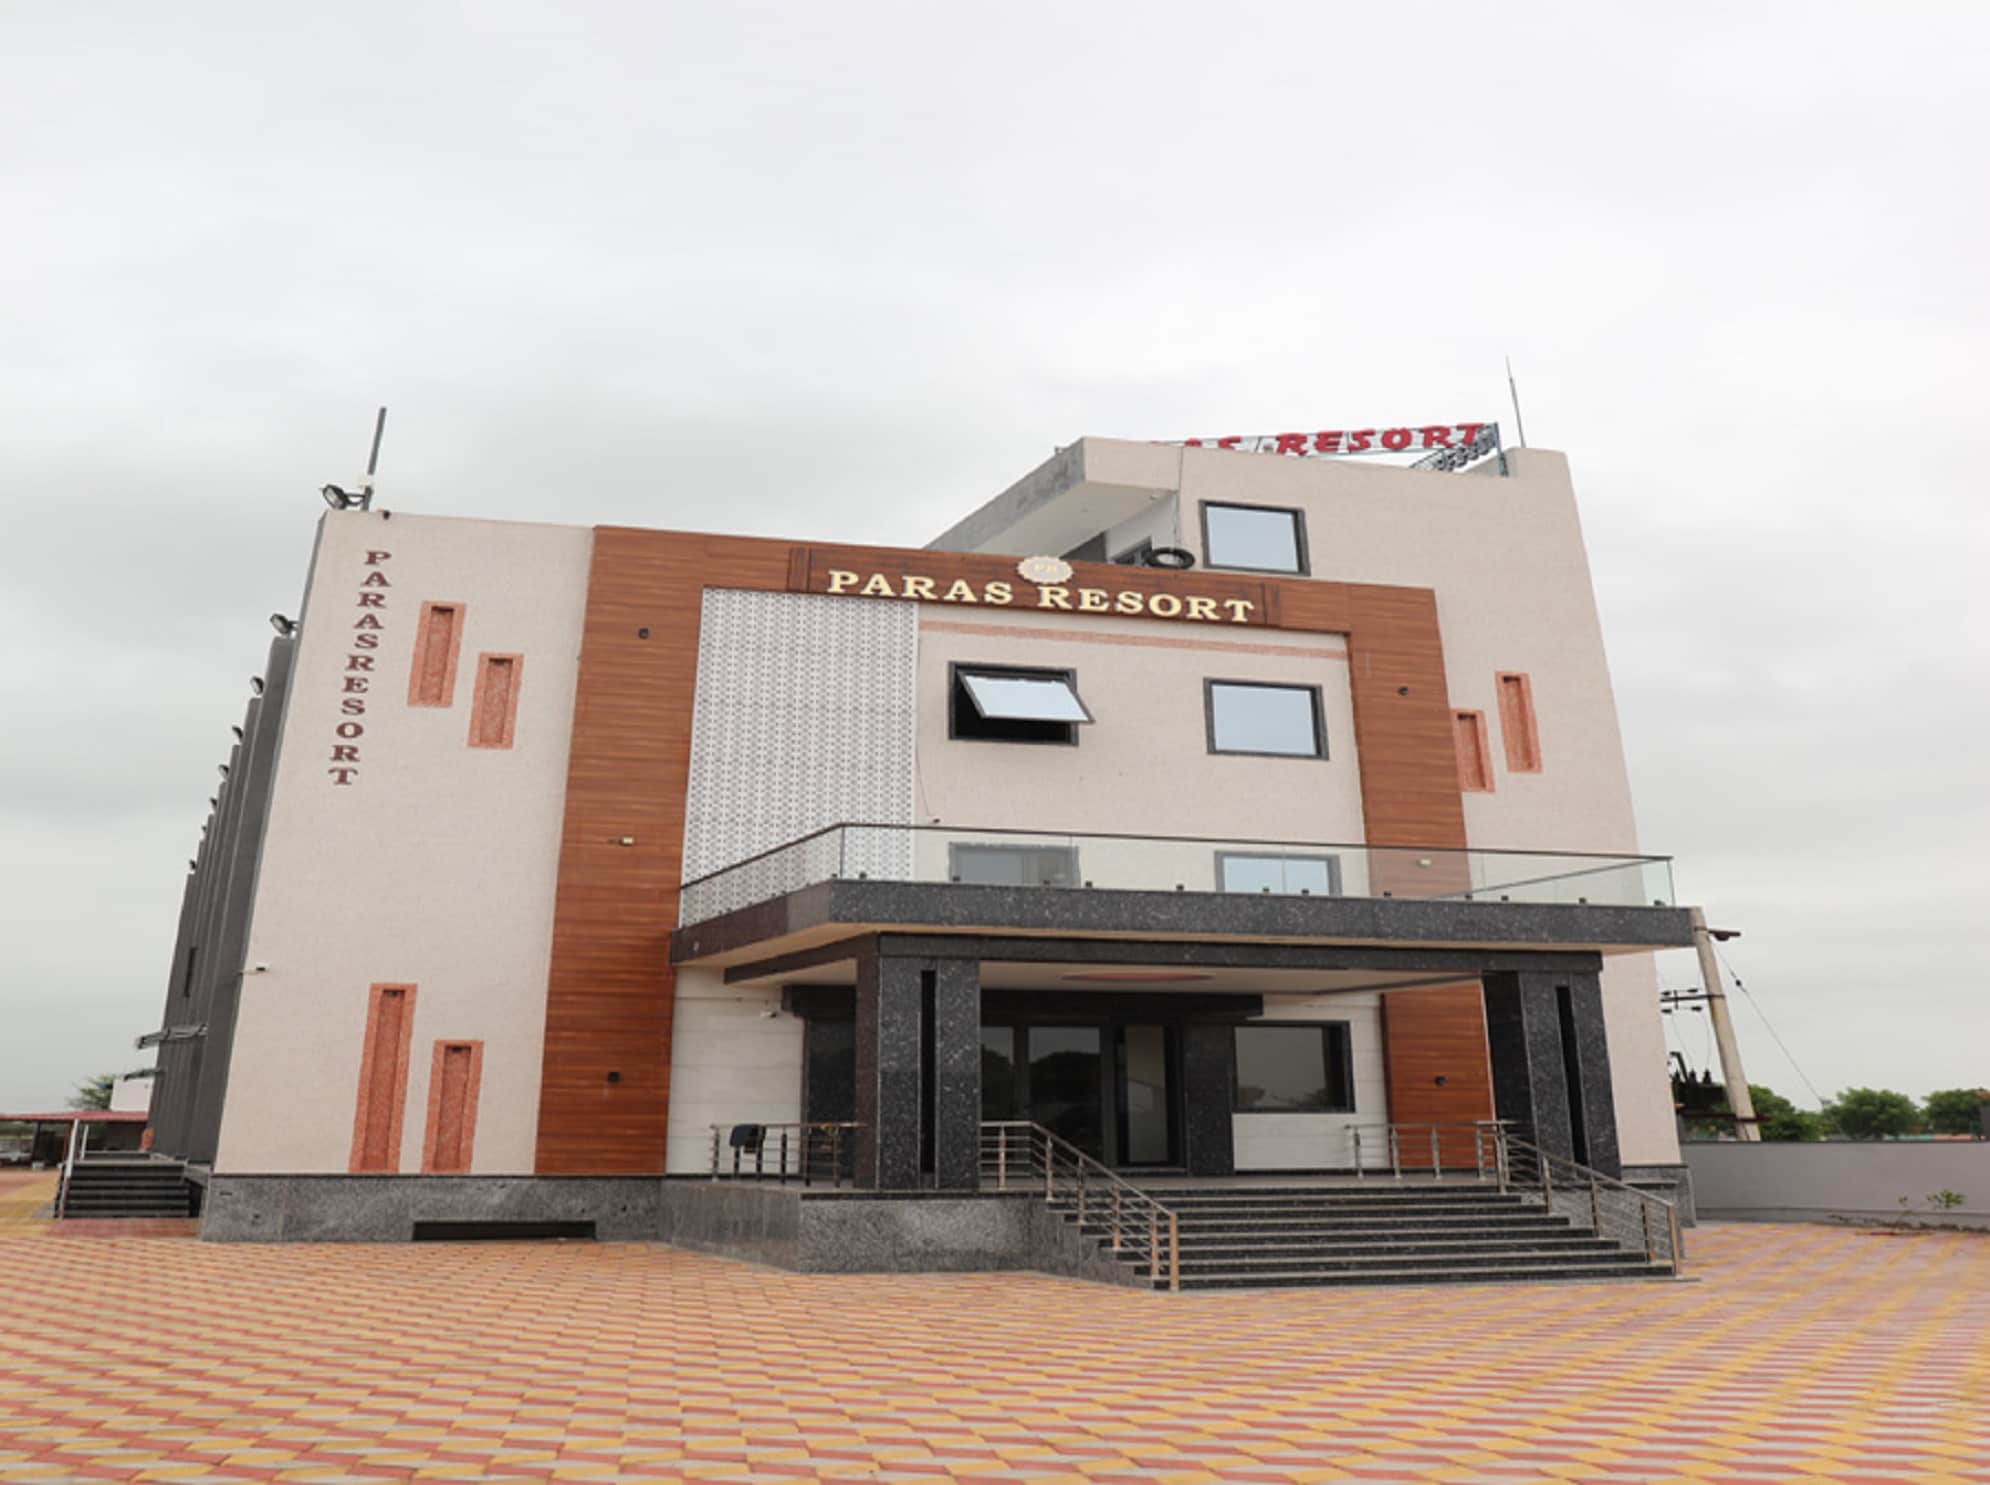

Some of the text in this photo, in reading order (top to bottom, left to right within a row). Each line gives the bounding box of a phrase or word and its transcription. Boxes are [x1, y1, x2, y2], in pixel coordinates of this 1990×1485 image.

[1276, 422, 1485, 456] RESORT
[827, 569, 1255, 622] PARAS RESORT
